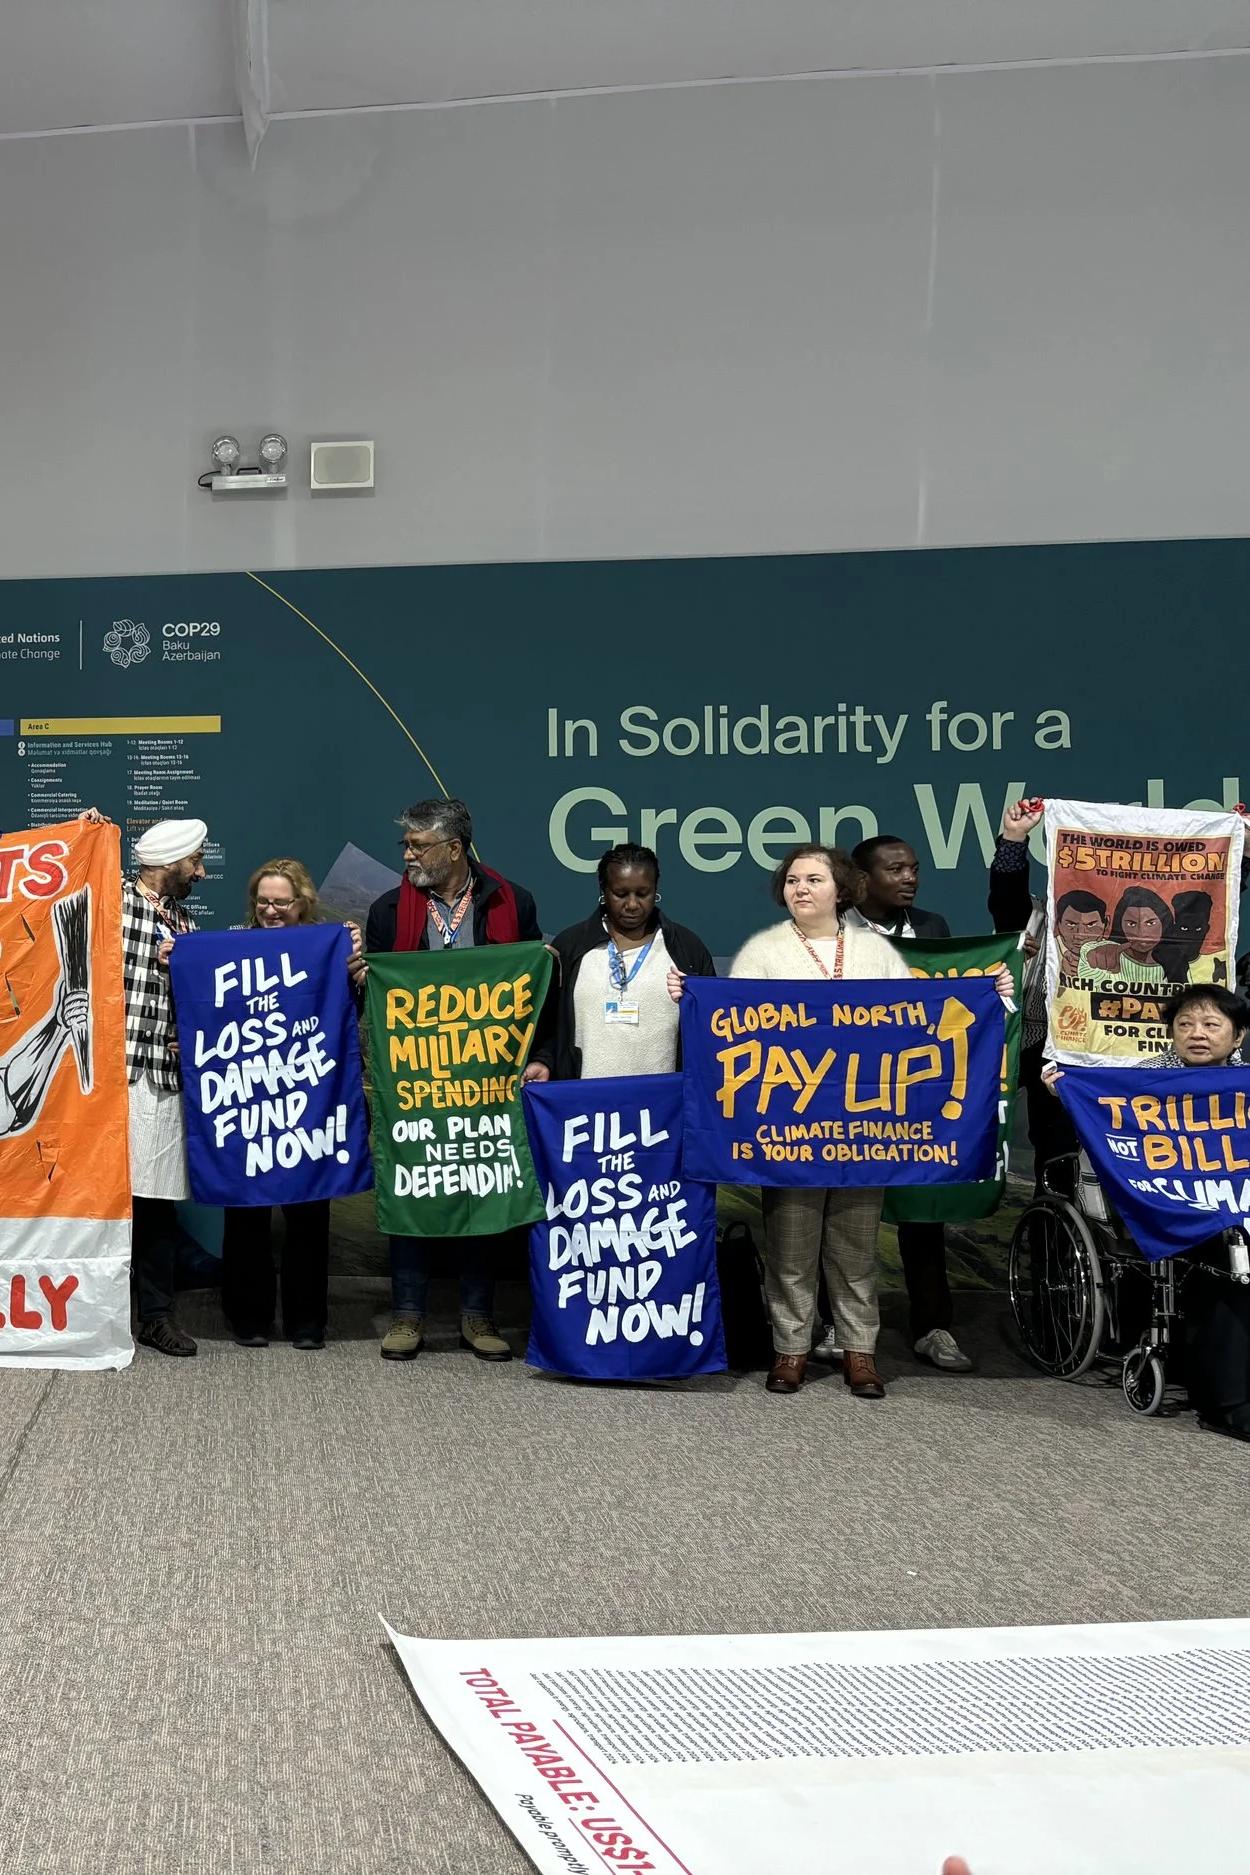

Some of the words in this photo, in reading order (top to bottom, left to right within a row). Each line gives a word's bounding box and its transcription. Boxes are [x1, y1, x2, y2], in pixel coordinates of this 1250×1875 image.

[17, 632, 60, 644] Nations
[162, 622, 221, 637] COP29
[162, 640, 190, 651] Baku
[21, 648, 60, 661] Change
[162, 650, 221, 663] Azerbaijan
[548, 707, 598, 757] In
[618, 702, 907, 764] Solidarity
[926, 700, 1014, 751] for
[1034, 709, 1072, 749] a
[548, 786, 878, 873] Green
[1061, 833, 1087, 845] THE
[1090, 836, 1143, 851] WORLD
[1146, 840, 1159, 851] IS
[1163, 841, 1206, 852] OWED
[1096, 869, 1108, 877] TO
[1110, 870, 1137, 880] FIGHT
[1141, 872, 1187, 881] CLIMATE
[1190, 872, 1225, 881] CHANGE
[214, 952, 308, 1008] FILL
[1059, 972, 1094, 991] RICH
[1101, 980, 1192, 996] COUNTR
[246, 991, 280, 1014] THE
[386, 973, 534, 1030] REDUCE
[1098, 996, 1167, 1020] #PA
[194, 1011, 287, 1068] LOSS
[291, 1015, 319, 1038] AND
[710, 1002, 817, 1042] GLOBAL
[831, 1001, 936, 1035] NORTH,
[1103, 1024, 1140, 1038] FOR
[390, 1021, 534, 1079] MILITARY
[716, 1038, 837, 1119] PAY
[844, 996, 976, 1120] UP!
[200, 1031, 337, 1115] DAMAGE
[214, 1090, 308, 1148] FUND
[391, 1117, 437, 1143] OUR
[447, 1113, 512, 1140] PLAN
[1098, 1091, 1250, 1132] TRILLI
[246, 1104, 350, 1177] NOW!
[425, 1138, 511, 1162] NEEDS
[562, 1108, 669, 1163] FILL
[755, 1120, 845, 1144] CLIMATE
[848, 1120, 934, 1142] FINANCE
[1106, 1137, 1138, 1157] NOT
[597, 1150, 635, 1174] THE
[732, 1141, 754, 1160] IS
[761, 1142, 815, 1162] YOUR
[822, 1140, 959, 1167] OBLIGATION!
[545, 1173, 643, 1221] LOSS
[647, 1180, 681, 1203] AND
[1128, 1178, 1158, 1194] FOR
[548, 1198, 698, 1271] DAMAGE
[558, 1260, 662, 1309] FUND
[585, 1281, 706, 1347] NOW!
[459, 1667, 522, 1719] TOTAL
[500, 1722, 601, 1812] PAYABLE:
[581, 1817, 656, 1875] US$1
[514, 1793, 553, 1830] Payable
